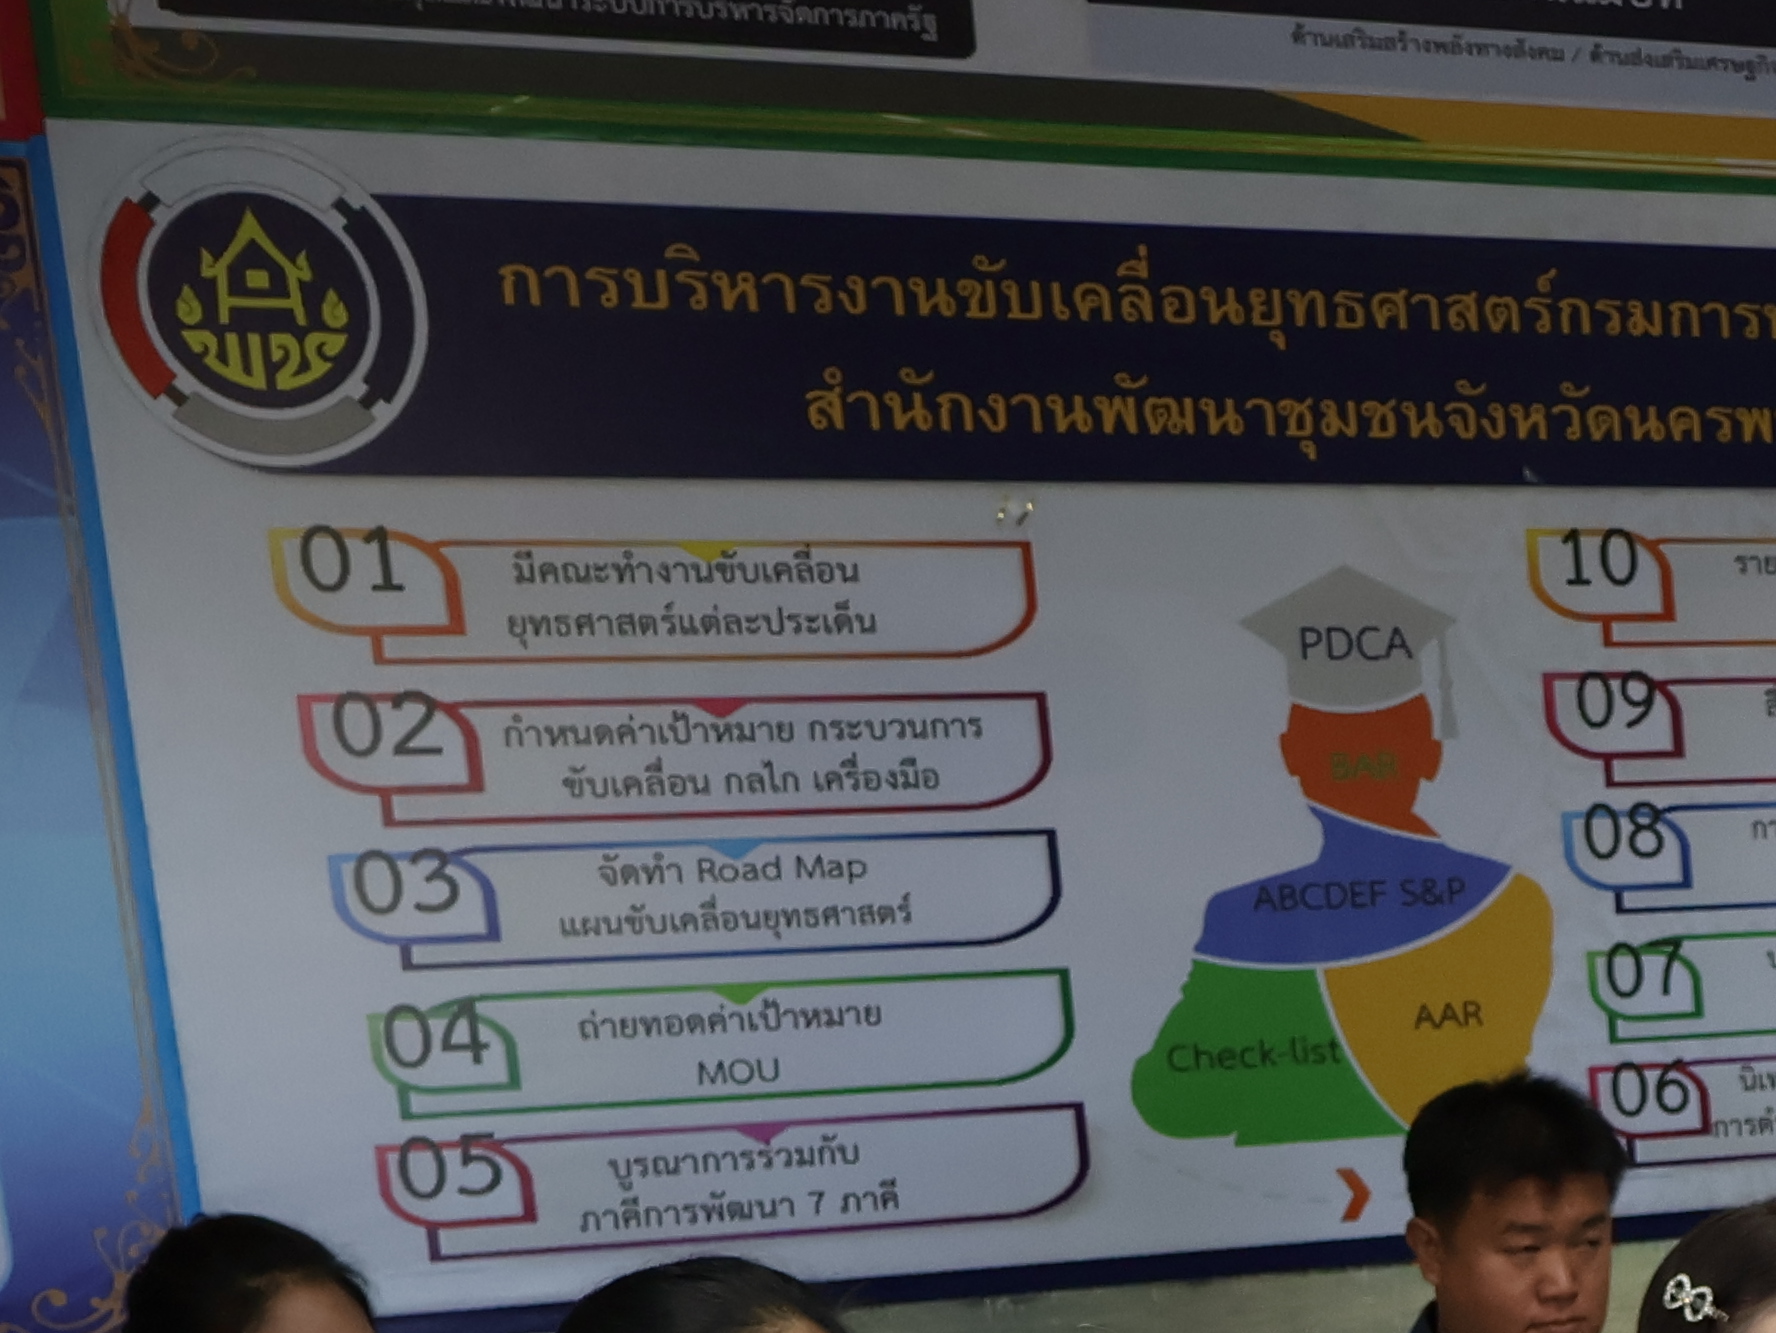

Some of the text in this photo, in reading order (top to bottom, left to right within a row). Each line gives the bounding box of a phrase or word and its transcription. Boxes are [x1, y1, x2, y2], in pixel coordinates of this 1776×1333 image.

[301, 523, 405, 593] 01
[512, 542, 860, 587] มีคณะทำงานขับเคลื่อน
[1561, 528, 1638, 587] 10
[507, 598, 877, 647] ยุทธศาสตร์แต่ละประเด็น
[1300, 625, 1413, 662] PDCA
[332, 690, 444, 757] 02
[1577, 670, 1657, 728] 09
[503, 712, 985, 750] กำหนดค่าเป้าหมาย กระบวนการ
[561, 754, 941, 799] ขับเคลื่อน กลไก เครื่องมือ
[1585, 802, 1664, 858] 08
[353, 846, 462, 915] 03
[597, 853, 868, 890] จัดทำ Road Map
[1253, 878, 1466, 912] ABCDEF S&P
[559, 893, 914, 944] แผนขับเคลื่อนยุทธศาสตร์
[1608, 938, 1683, 998] 07
[383, 1000, 490, 1068] 04
[578, 1000, 884, 1043] ถ่ายทอดค่าเป้าหมาย
[1415, 1002, 1484, 1030] AAR
[698, 1057, 781, 1086] MOU
[1167, 1038, 1342, 1073] Check-list
[1611, 1060, 1691, 1116] 06
[400, 1133, 504, 1199] 05
[608, 1139, 860, 1190] บูรณาการร่วมกับ
[580, 1179, 901, 1234] ภาคีการพัฒนา 7 ภาคี
